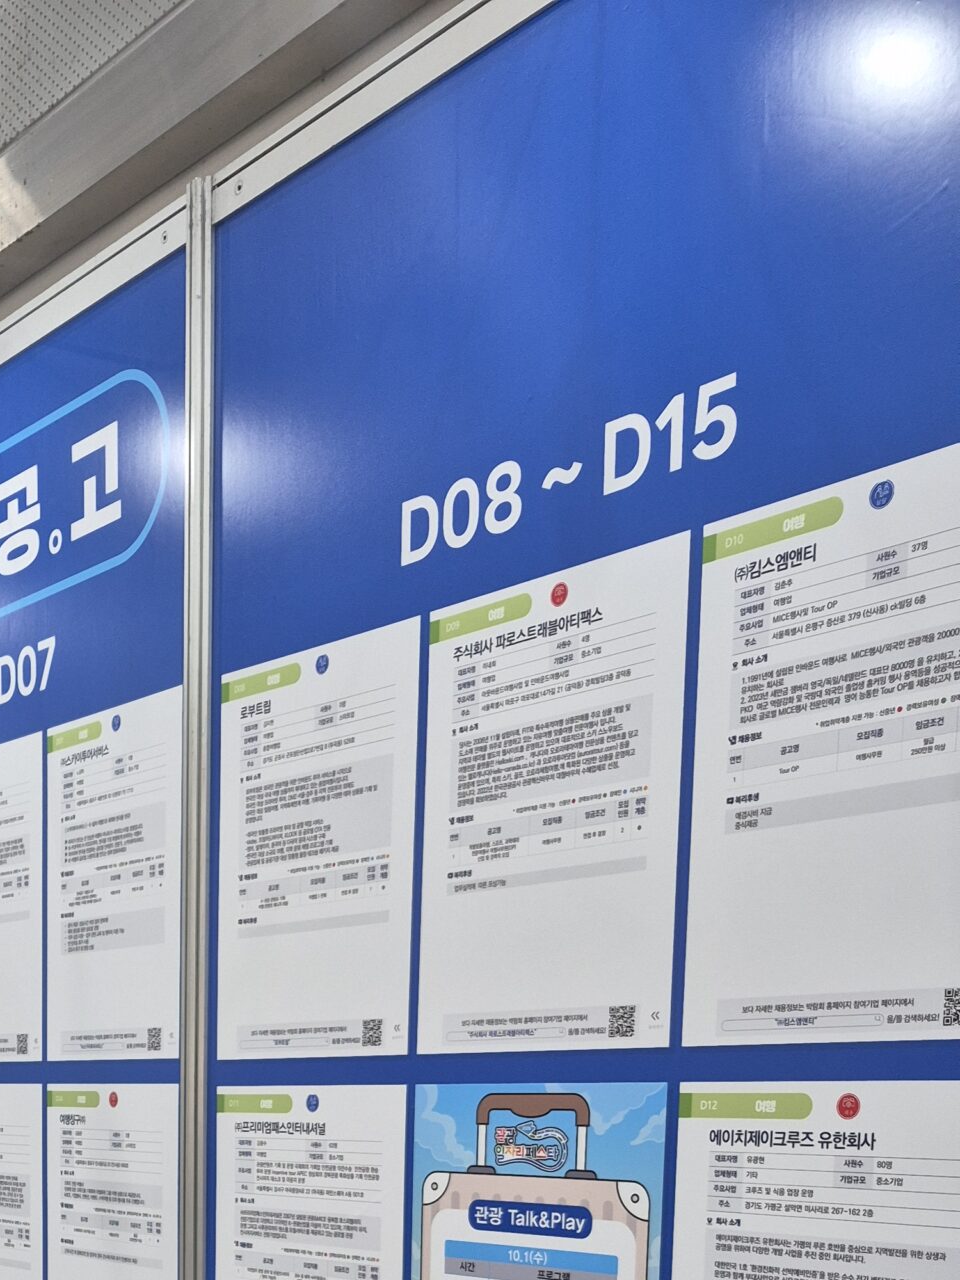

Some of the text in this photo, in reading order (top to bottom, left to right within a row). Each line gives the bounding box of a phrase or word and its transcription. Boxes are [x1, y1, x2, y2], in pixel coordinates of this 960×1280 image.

[725, 533, 743, 549] D10
[740, 585, 765, 600] 대표자명
[876, 548, 897, 563] 사원수
[911, 539, 928, 553] 37명
[739, 565, 900, 617] 업체형태 여행업 기업규모
[739, 618, 763, 633] 주요사업
[810, 602, 825, 614] Tour
[826, 599, 837, 610] OP
[744, 636, 756, 648] 주소
[771, 624, 803, 641] 서울특별시
[805, 619, 824, 633] 은평구
[847, 610, 861, 622] 379
[862, 603, 888, 620] (신사동)
[914, 594, 926, 606] 6층
[453, 637, 492, 663] 주식회사
[741, 653, 767, 667] 회사 소개
[780, 716, 944, 755] 공고명 모집직종 임금조건
[735, 792, 759, 804] 복리후생
[742, 997, 914, 1013] 보다 자세한 채용정보는 박람회 홈페이지 참여기업 페이지에서
[903, 1012, 939, 1023] 검색하세요!
[700, 1100, 776, 1112] D12 여행
[709, 1129, 876, 1150] 에이치제이크루즈 유한회사
[714, 1154, 892, 1169] 대표자명 유광현 사원수 80명
[714, 1169, 903, 1186] 업체형태 기타 기업규모 중소기업
[713, 1184, 736, 1193] 주요사업
[745, 1186, 762, 1195] 크루즈
[764, 1187, 771, 1195] 및
[800, 1189, 813, 1198] 운영
[718, 1199, 730, 1208] 주소
[744, 1201, 762, 1210] 경기도
[764, 1202, 782, 1212] 가평군
[804, 1205, 829, 1215] 미사리로
[831, 1206, 860, 1217] 267-162
[862, 1208, 873, 1218] 2층
[474, 1205, 585, 1233] 관광 Talk&Play
[716, 1217, 740, 1226] 회사 소개
[507, 1249, 547, 1266] 10.1(수)
[459, 1261, 475, 1272] 시간
